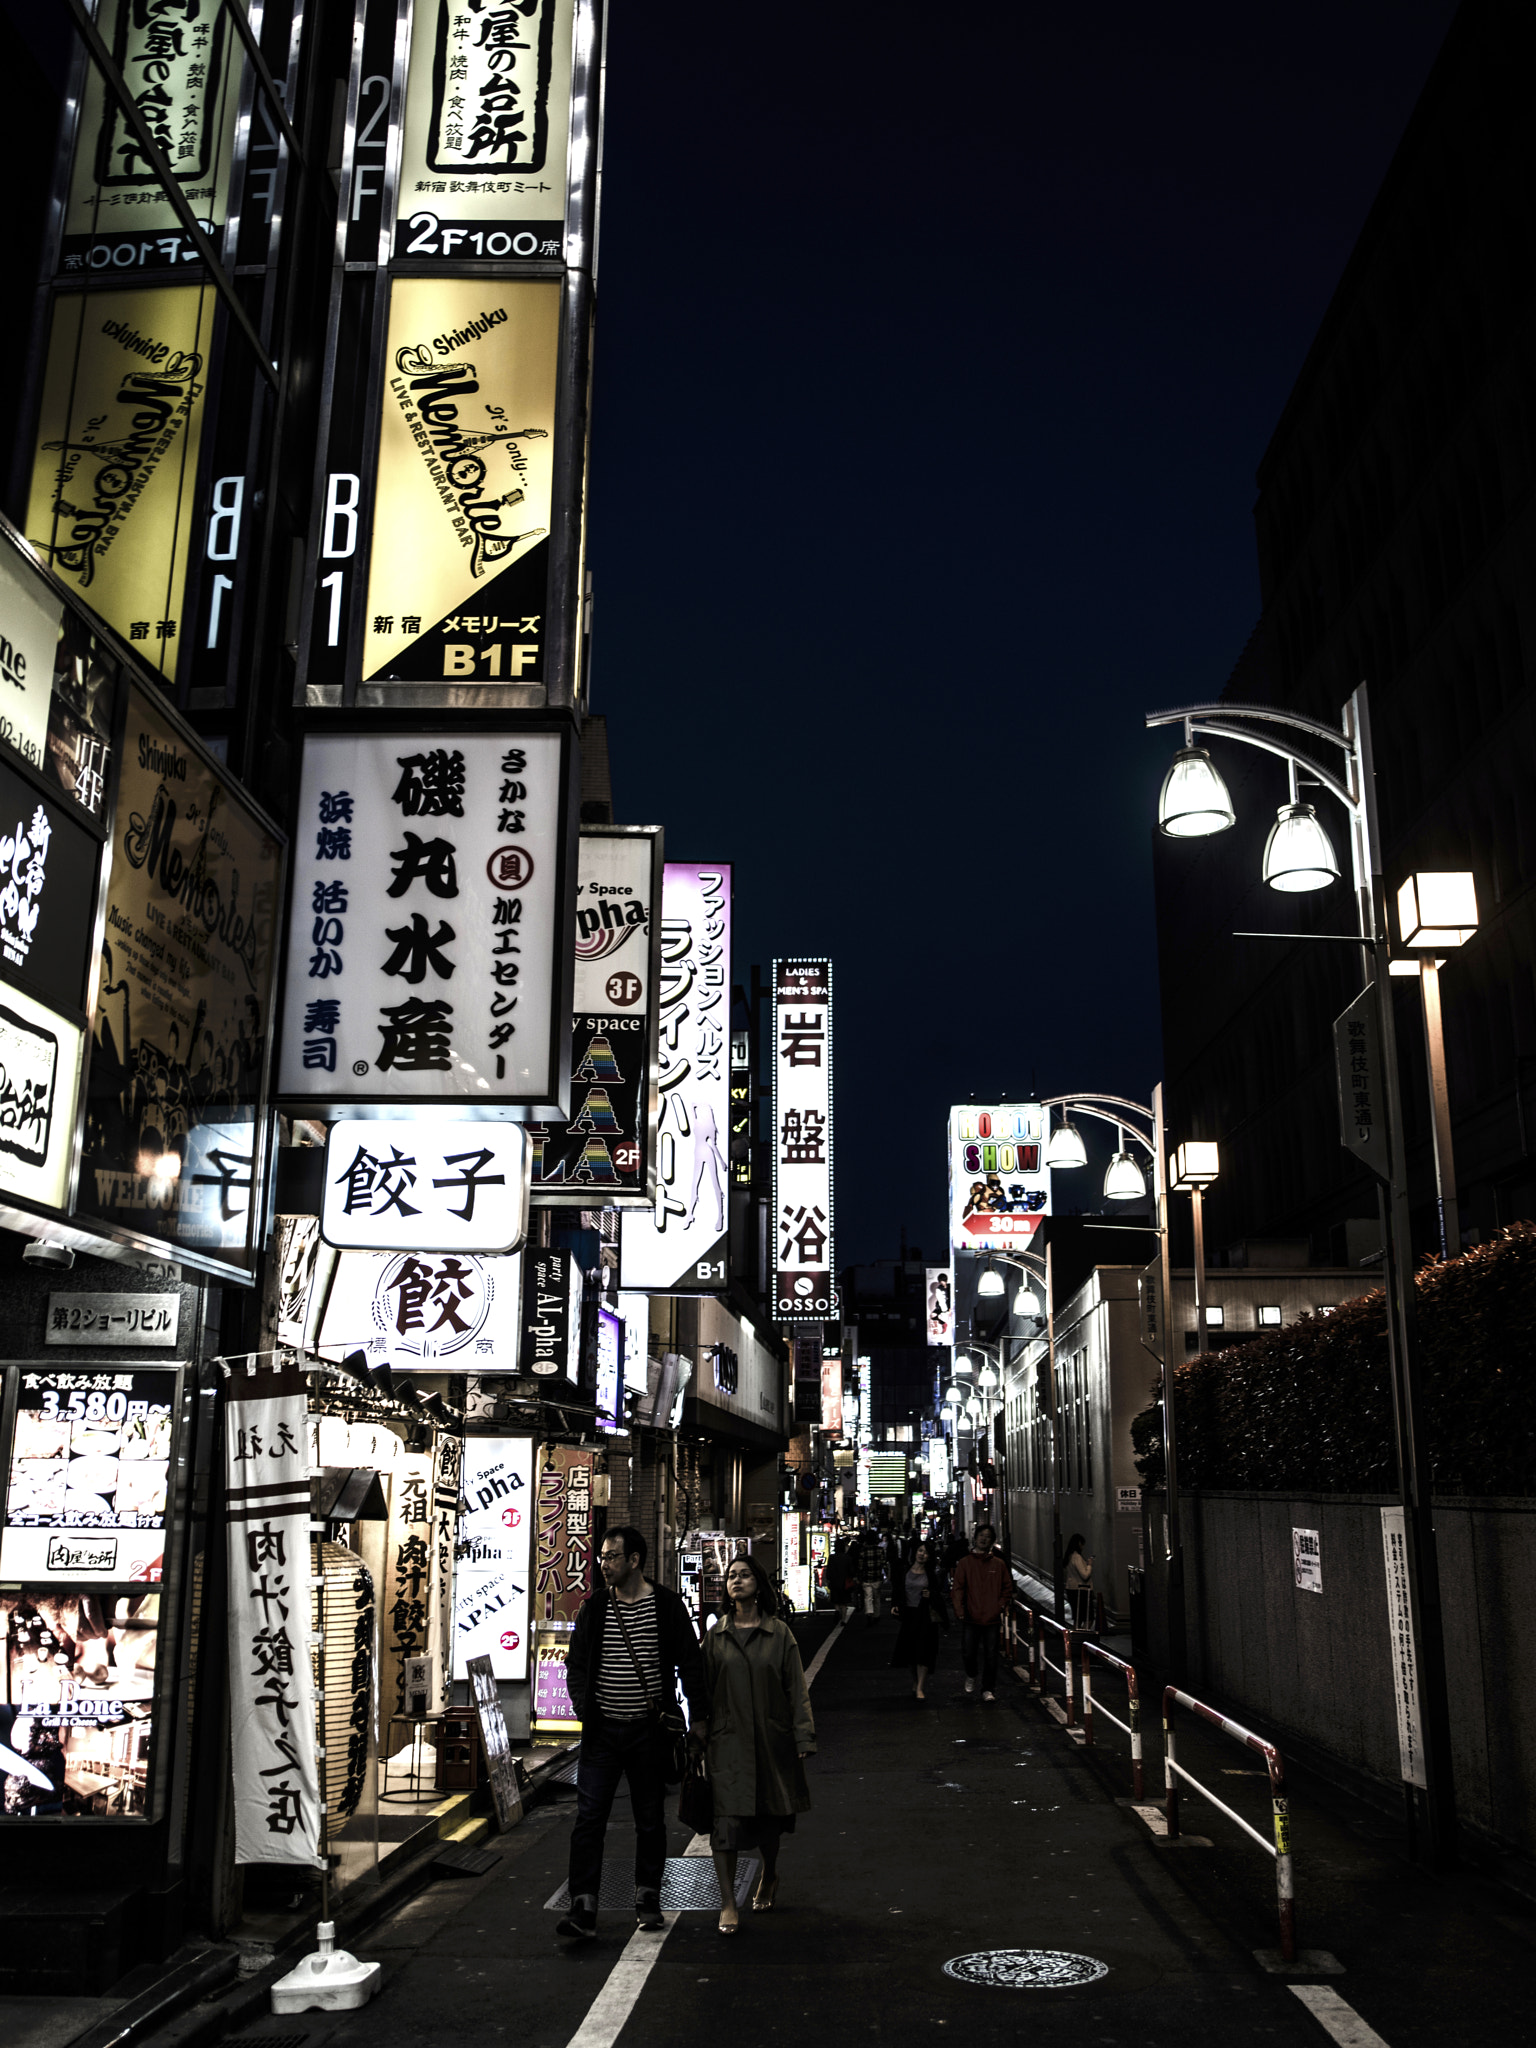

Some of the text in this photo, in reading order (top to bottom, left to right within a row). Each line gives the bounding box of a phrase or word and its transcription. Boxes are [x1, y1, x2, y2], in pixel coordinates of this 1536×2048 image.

[444, 15, 471, 151] 和牛・焼肉・食べ放題
[432, 307, 509, 356] Shinjuku
[485, 404, 508, 432] It's
[389, 376, 414, 412] LIVE
[407, 421, 462, 522] RESTAURANT
[451, 514, 474, 548] BAR
[373, 615, 422, 635] 新宿
[441, 615, 541, 635] メモリーズ
[443, 643, 539, 677] B1F
[138, 733, 187, 782] Shinjuku
[497, 749, 528, 834] さかな
[588, 882, 633, 897] Space
[374, 748, 466, 1072] 磯丸水産
[302, 790, 355, 1073] 浜焼 活いか 寿司
[696, 872, 725, 1081] ファッションヘルス
[785, 968, 820, 976] LADIES
[799, 977, 808, 986] &
[488, 896, 523, 1080] 加工センター
[609, 978, 638, 999] 3F
[777, 986, 828, 996] MEN'S SPA
[586, 1017, 641, 1034] space
[654, 918, 698, 1233] ラブインハート
[1348, 1021, 1374, 1144] 歌舞伎町東通り
[779, 1012, 828, 1264] 岩盤浴
[959, 1110, 1044, 1141] ROBOT
[616, 1149, 640, 1165] 2F
[964, 1143, 1041, 1174] SHOW
[335, 1144, 506, 1222] 餃子
[989, 1216, 1031, 1233] 30m
[536, 1255, 563, 1289] party space
[697, 1261, 725, 1279] B-1
[384, 1256, 475, 1336] 餃
[778, 1298, 829, 1311] OSSO
[51, 1305, 172, 1332] 第2ショーリビル
[528, 1292, 564, 1357] AL-pha
[822, 1347, 839, 1356] 2F
[22, 1372, 134, 1391] 食べ飲み放題
[476, 1462, 505, 1480] Space
[399, 1471, 428, 1525] 元祖
[1120, 1490, 1137, 1498] 休日
[8, 1510, 163, 1528] 全コース飲み放題付き
[566, 1465, 591, 1593] 店舗型ヘルス
[129, 1560, 163, 1582] 2F
[458, 1583, 527, 1638] APALA
[501, 1635, 519, 1647] 2F
[57, 1679, 123, 1715] Bone
